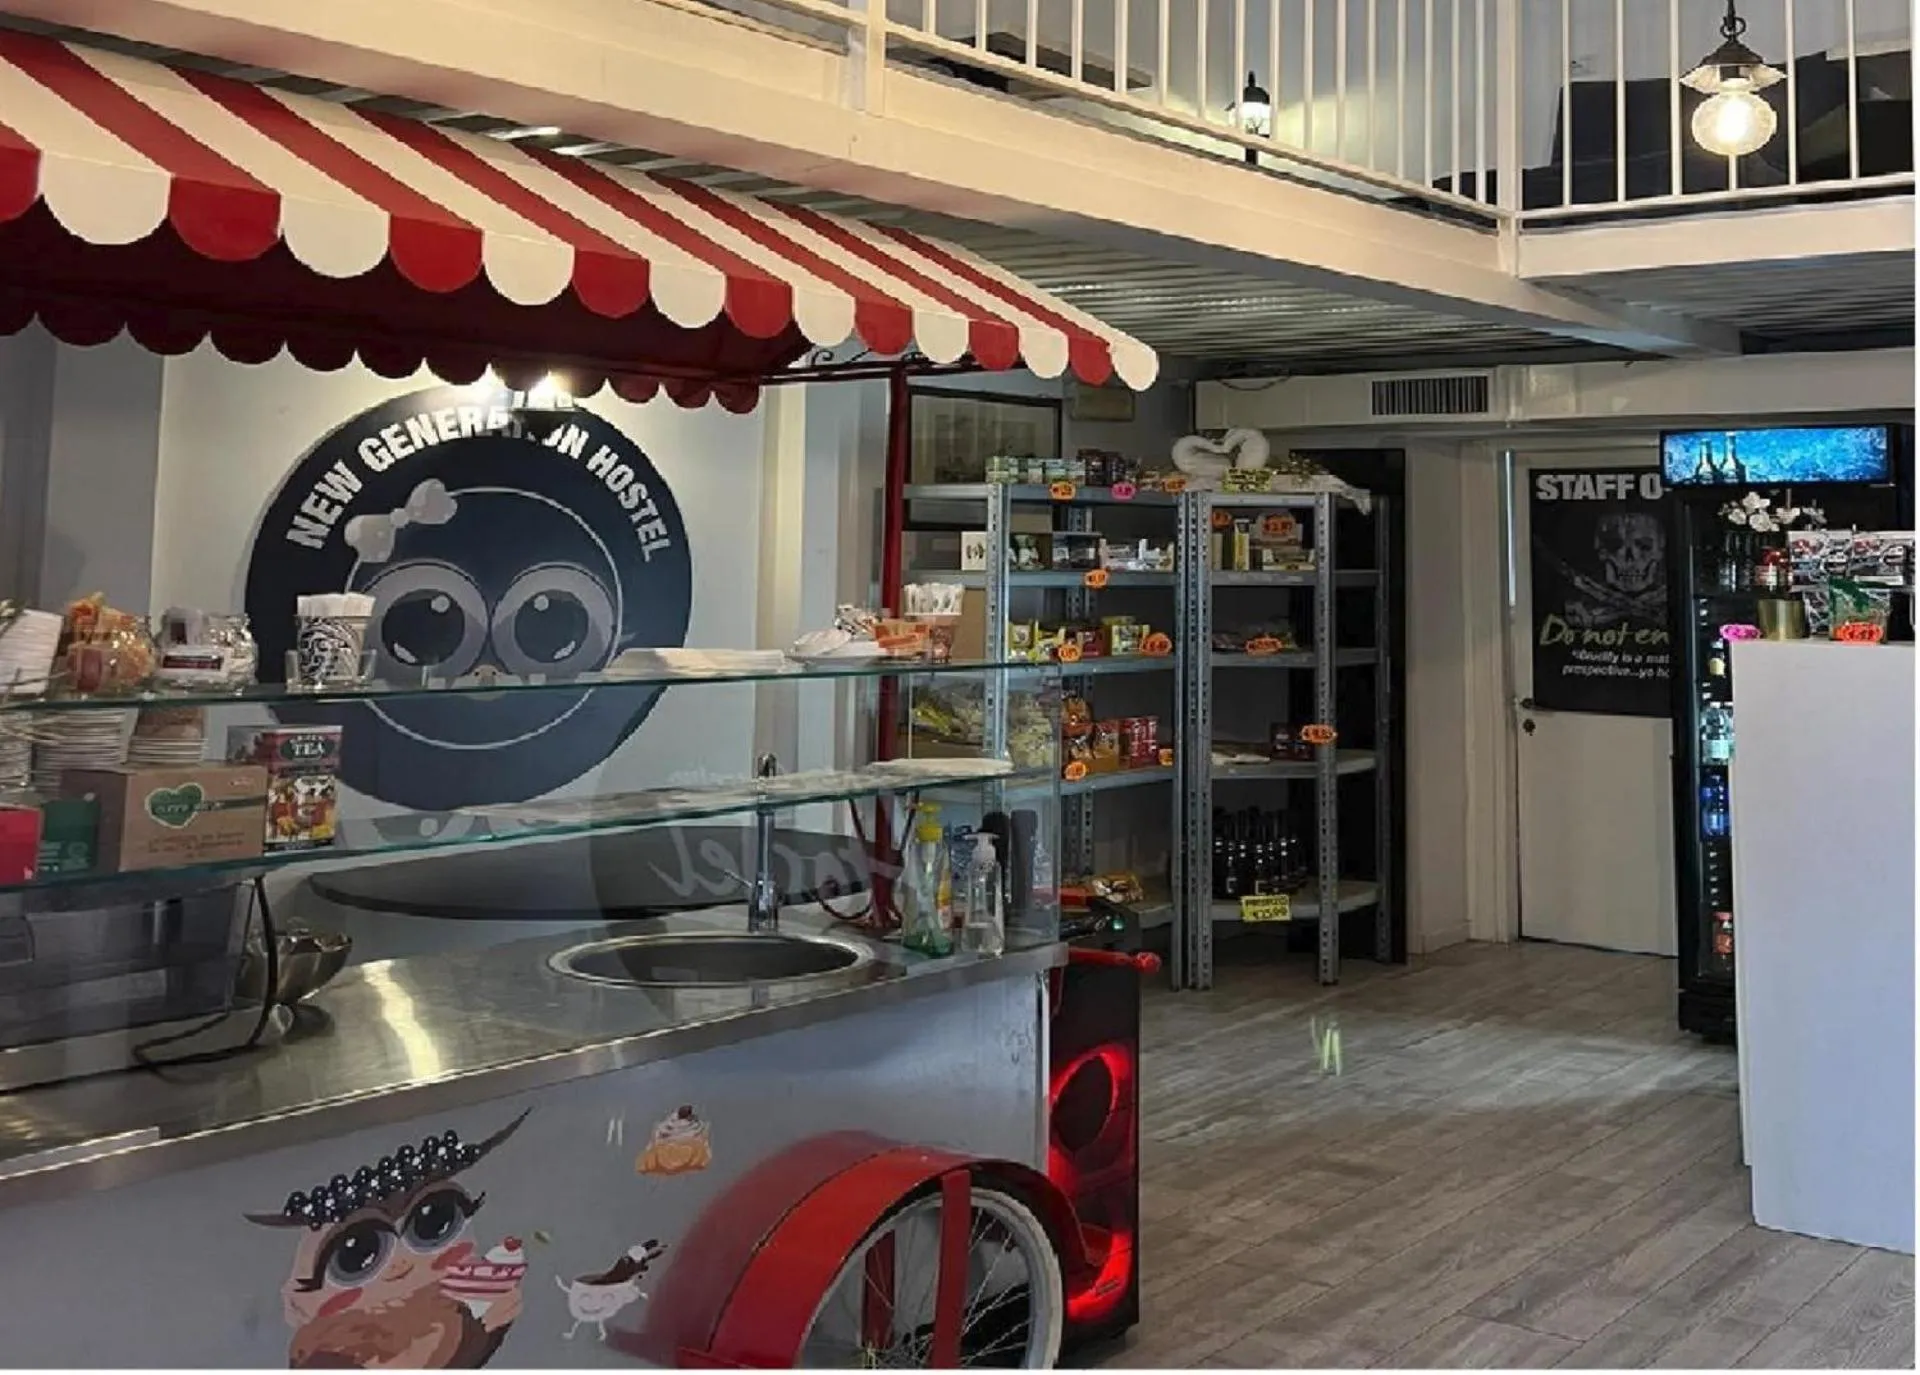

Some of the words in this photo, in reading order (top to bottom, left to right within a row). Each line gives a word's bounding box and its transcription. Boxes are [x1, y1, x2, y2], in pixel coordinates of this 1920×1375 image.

[1535, 473, 1635, 500] STAFF
[1639, 472, 1664, 500] O
[286, 459, 363, 549] NEW
[586, 444, 671, 562] HOSTEL
[1539, 613, 1575, 646] Do
[1581, 621, 1634, 646] not
[1634, 628, 1670, 646] en
[293, 741, 327, 757] TEA
